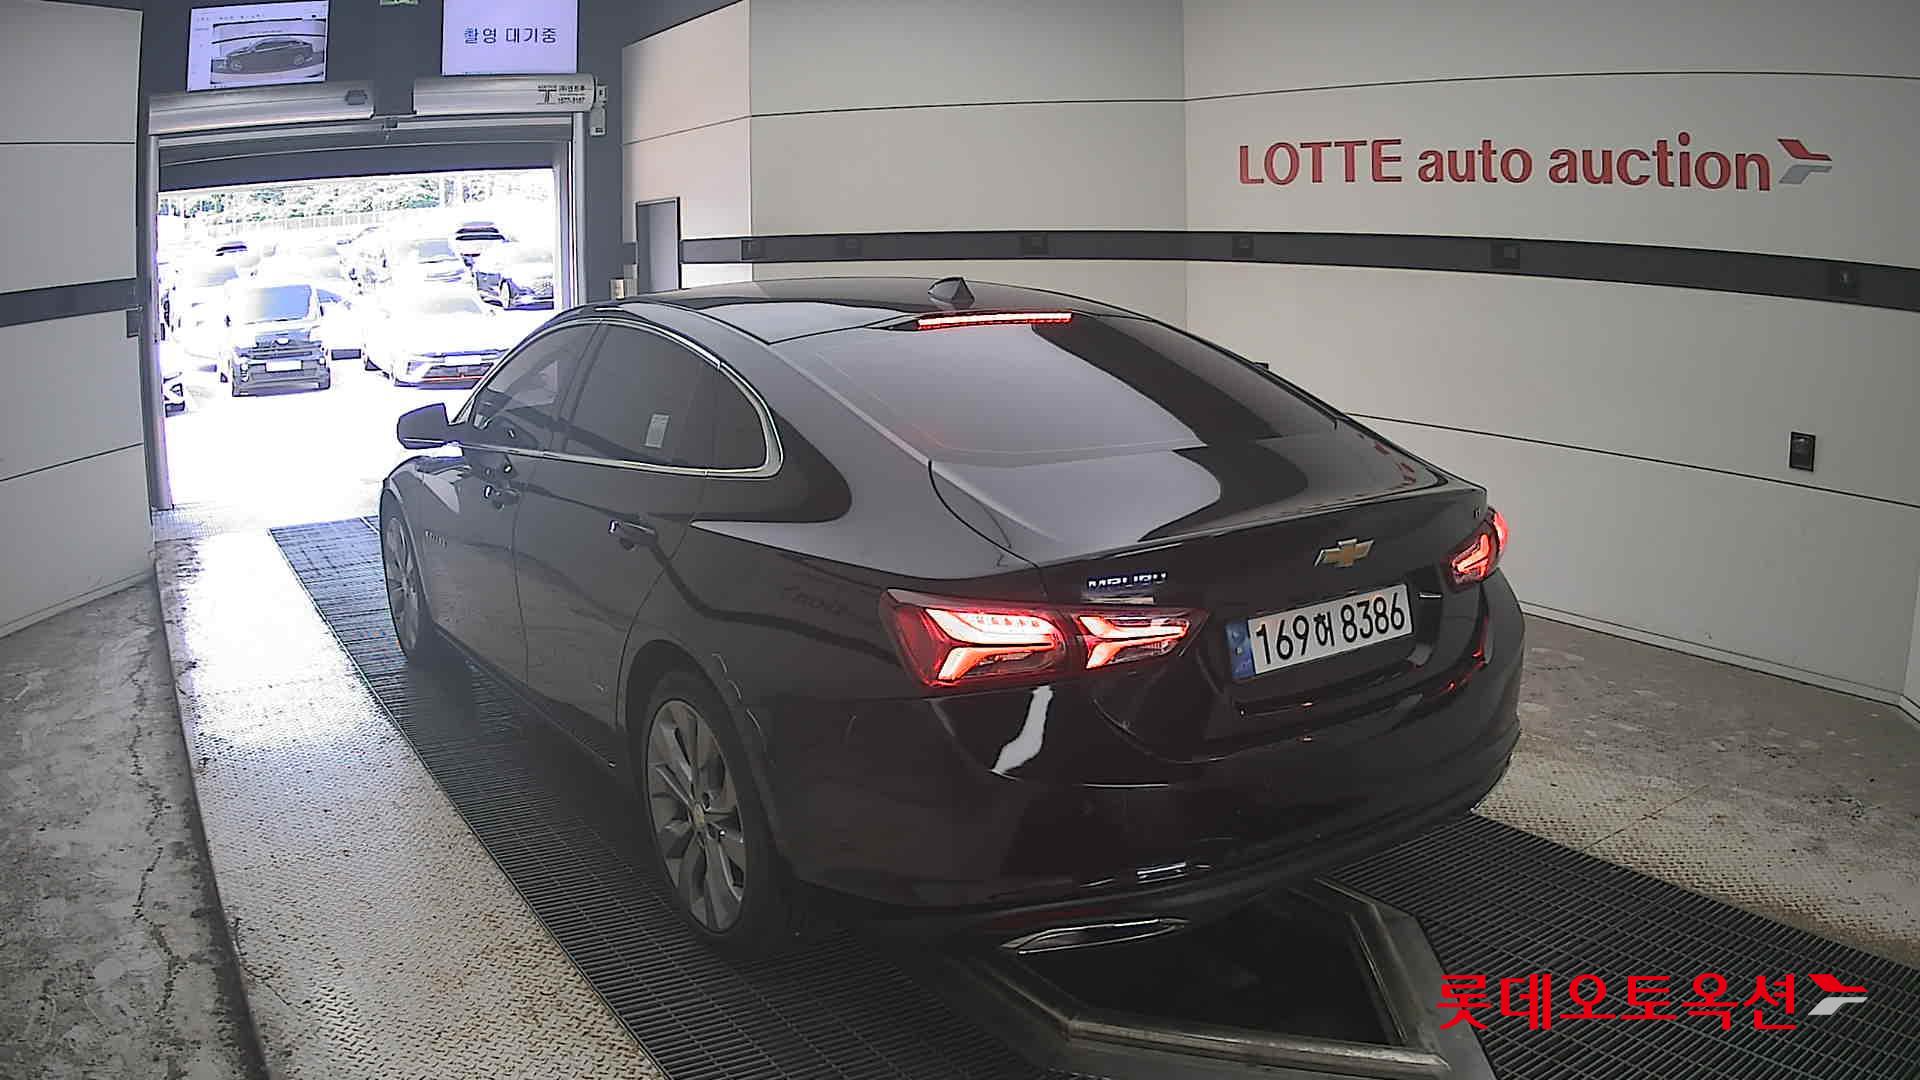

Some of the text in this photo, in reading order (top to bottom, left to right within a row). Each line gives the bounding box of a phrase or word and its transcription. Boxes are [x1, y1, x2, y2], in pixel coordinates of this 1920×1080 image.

[464, 27, 557, 44] 촬영 대기중
[1238, 131, 1772, 192] LOTTE auto auction
[1255, 592, 1405, 665] 169허 8386
